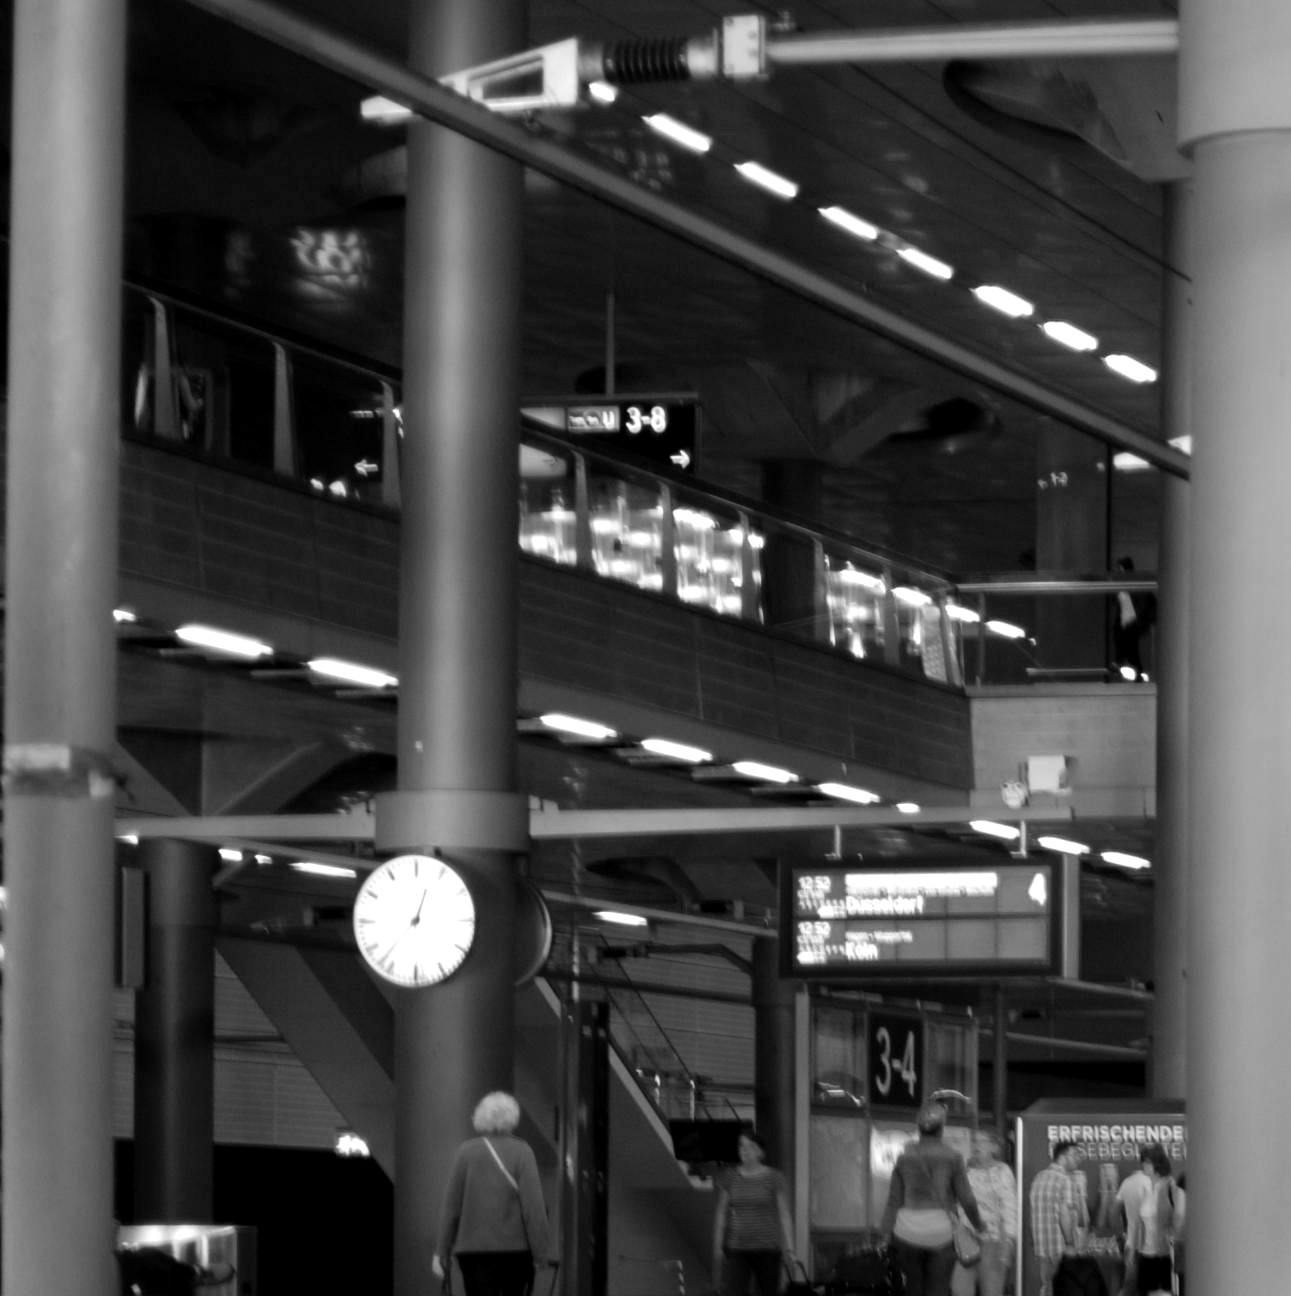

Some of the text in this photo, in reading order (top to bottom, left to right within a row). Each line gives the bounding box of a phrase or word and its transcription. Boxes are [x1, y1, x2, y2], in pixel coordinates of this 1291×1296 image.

[625, 406, 666, 434] 3-8
[875, 1026, 917, 1098] 3-4
[1047, 1125, 1188, 1143] ERFRISCHENDE
